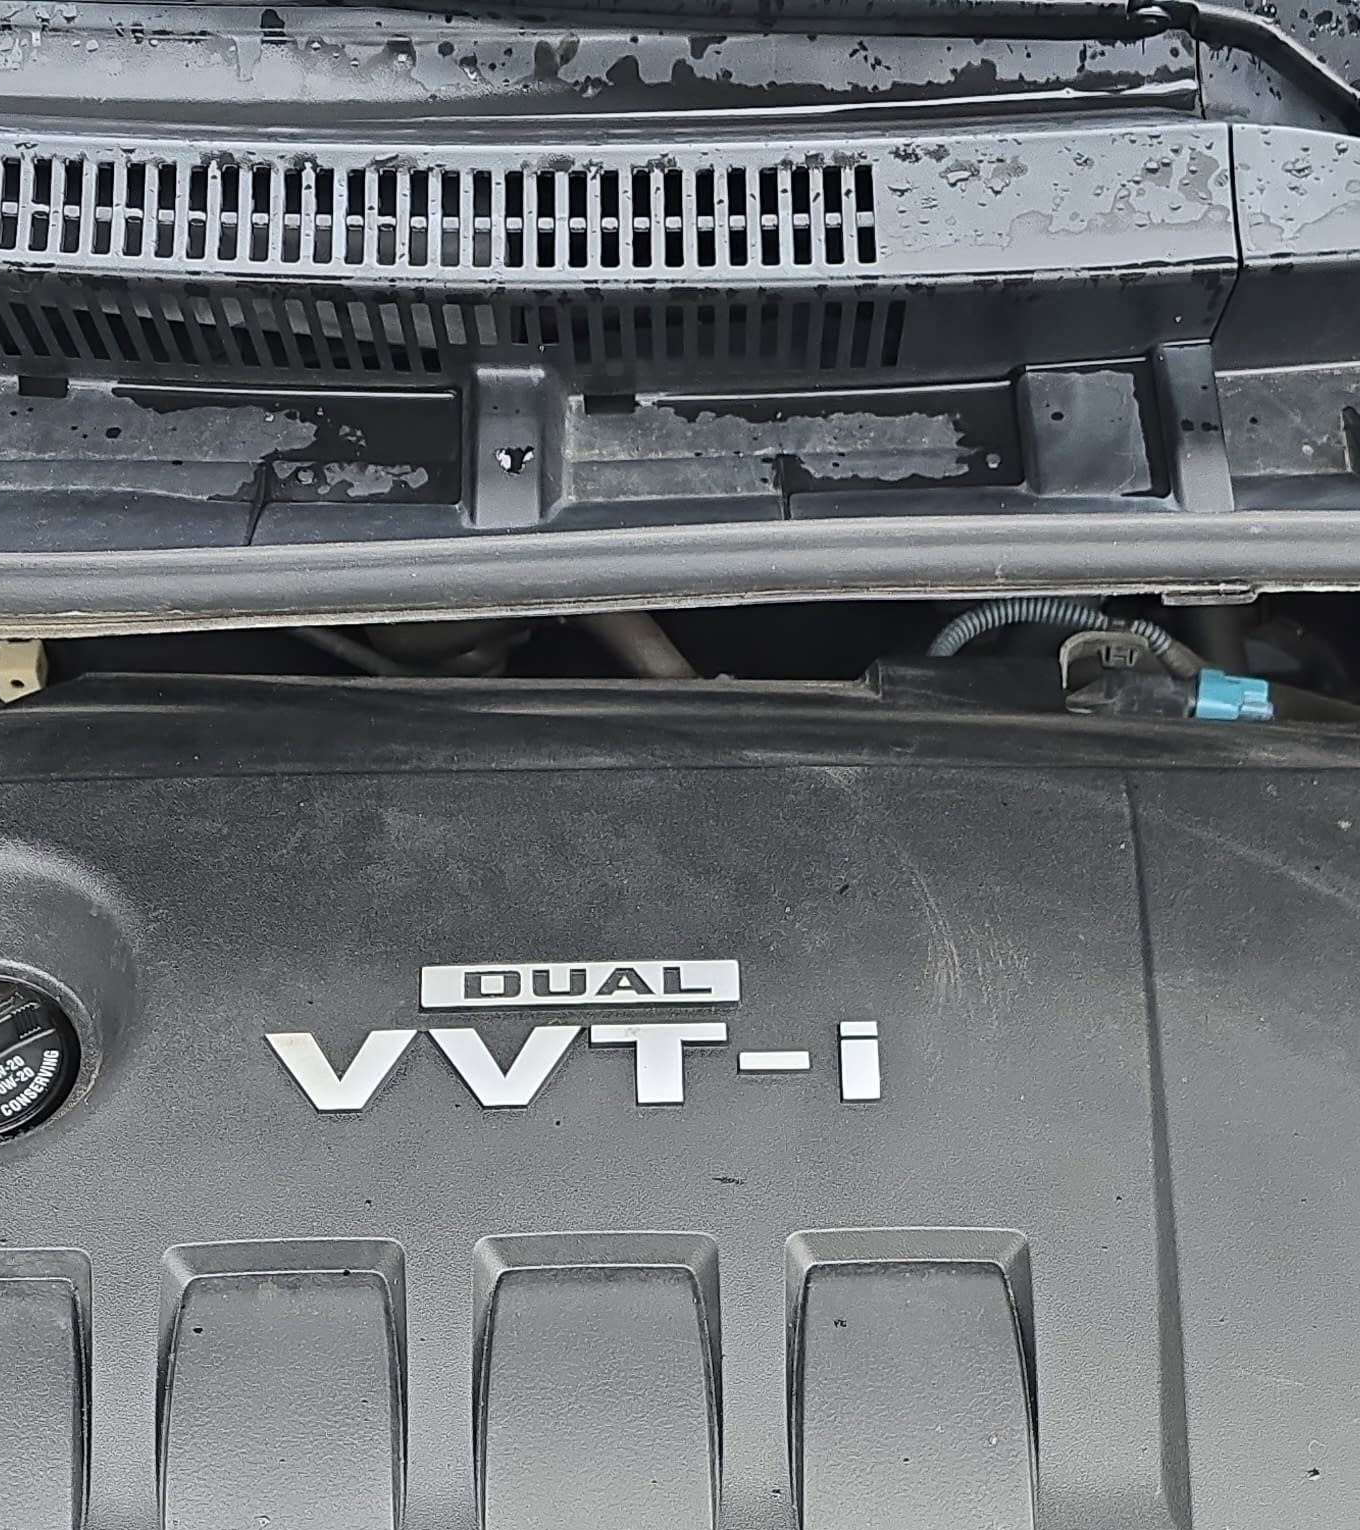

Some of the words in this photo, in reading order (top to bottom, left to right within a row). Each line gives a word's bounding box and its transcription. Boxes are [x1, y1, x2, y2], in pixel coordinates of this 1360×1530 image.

[463, 966, 712, 1000] DUAL
[0, 1050, 59, 1117] CONSERVING
[265, 1020, 881, 1113] VVT-i
